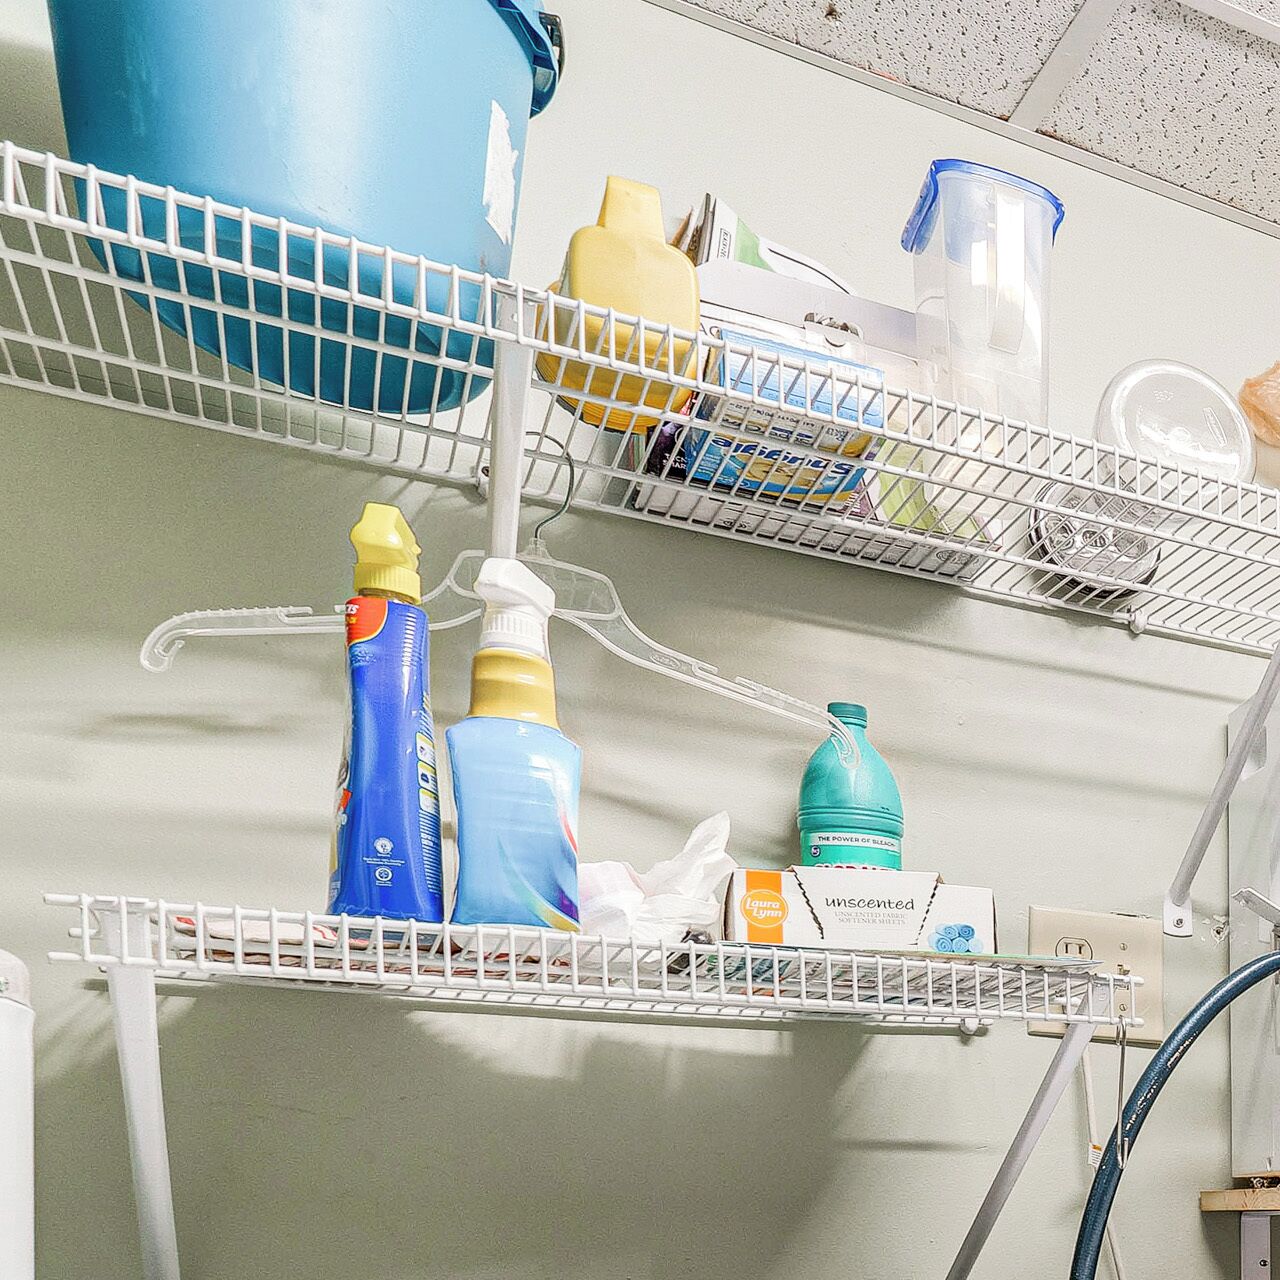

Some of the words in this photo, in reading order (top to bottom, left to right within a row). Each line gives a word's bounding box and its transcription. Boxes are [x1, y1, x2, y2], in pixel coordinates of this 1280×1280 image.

[746, 897, 781, 909] Laura
[825, 897, 915, 910] unscented
[752, 907, 783, 919] Lynn
